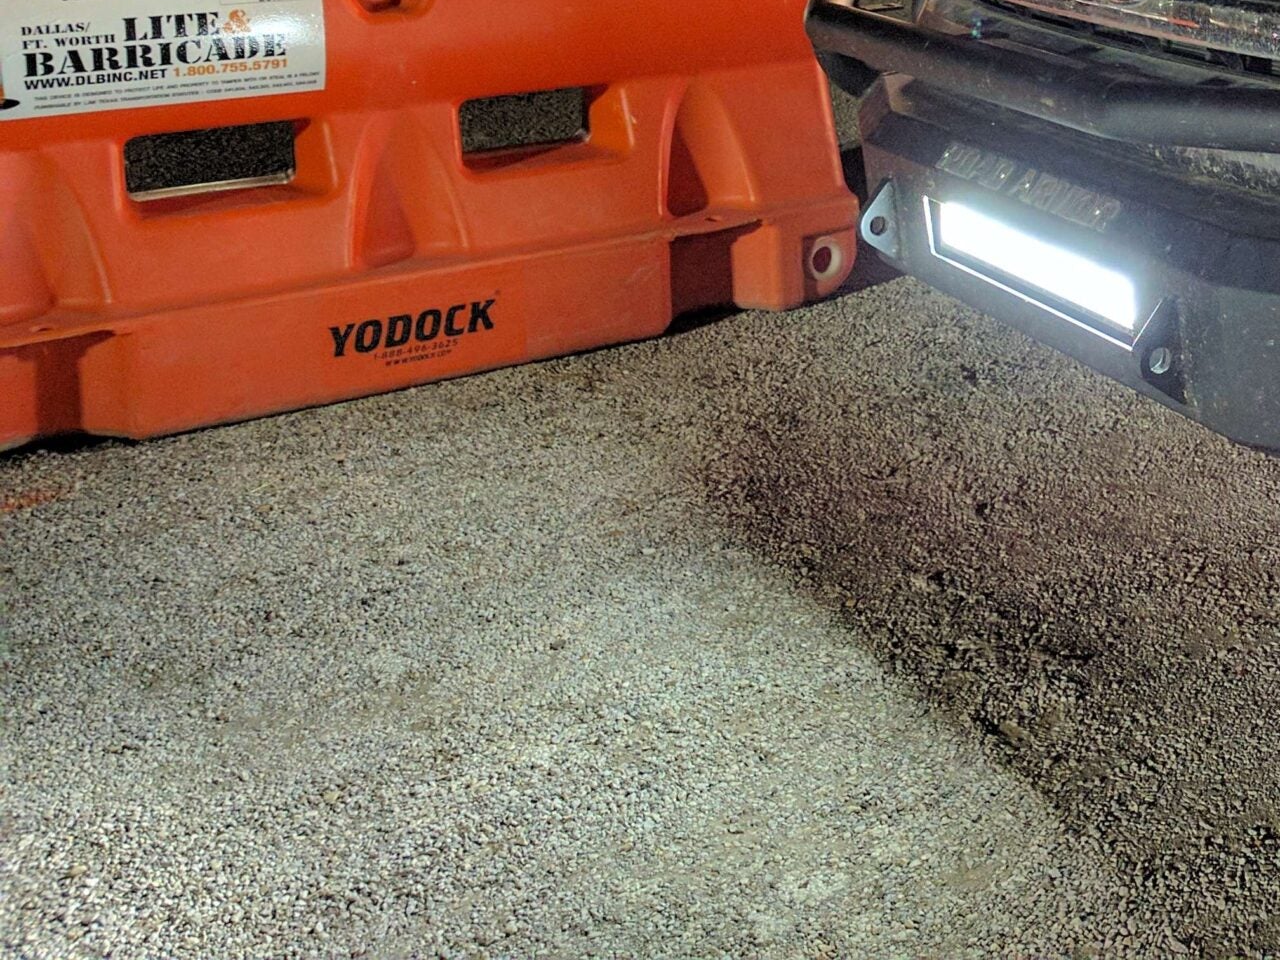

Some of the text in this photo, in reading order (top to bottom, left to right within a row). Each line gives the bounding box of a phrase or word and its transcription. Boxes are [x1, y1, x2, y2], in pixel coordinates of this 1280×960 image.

[21, 22, 90, 36] DALLAS/
[122, 9, 250, 42] LITE &
[22, 34, 115, 50] FT. WORTH
[23, 34, 286, 77] BARRICADE
[24, 59, 289, 90] WWW.DLBINC.NET 1.800.755.5791
[329, 298, 496, 357] YODOCK
